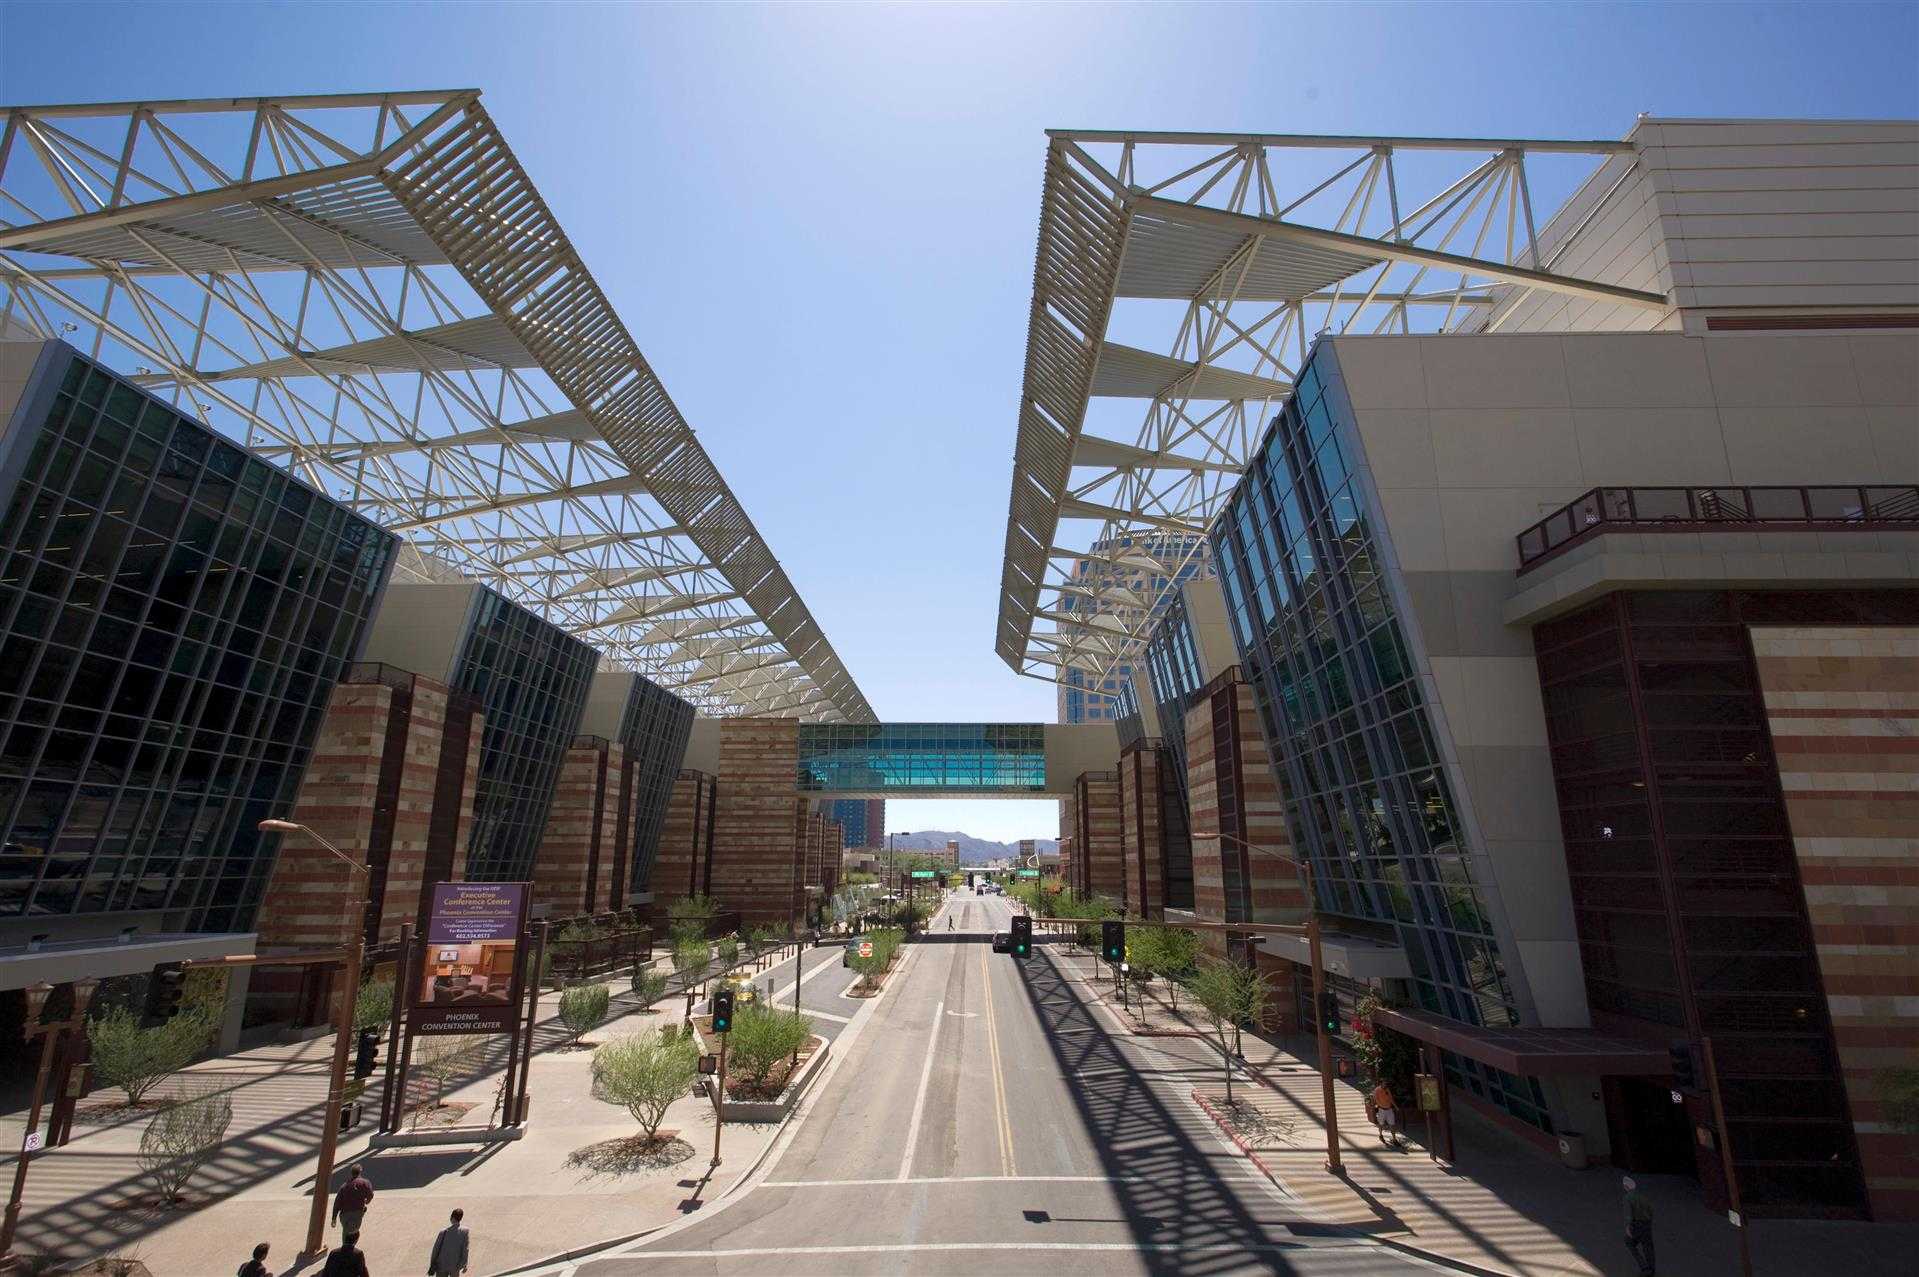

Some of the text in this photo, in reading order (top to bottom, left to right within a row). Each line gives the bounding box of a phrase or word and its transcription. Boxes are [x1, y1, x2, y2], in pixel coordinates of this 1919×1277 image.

[446, 1013, 480, 1021] PHOENIX
[421, 1021, 502, 1030] CONVENTION CENTER
